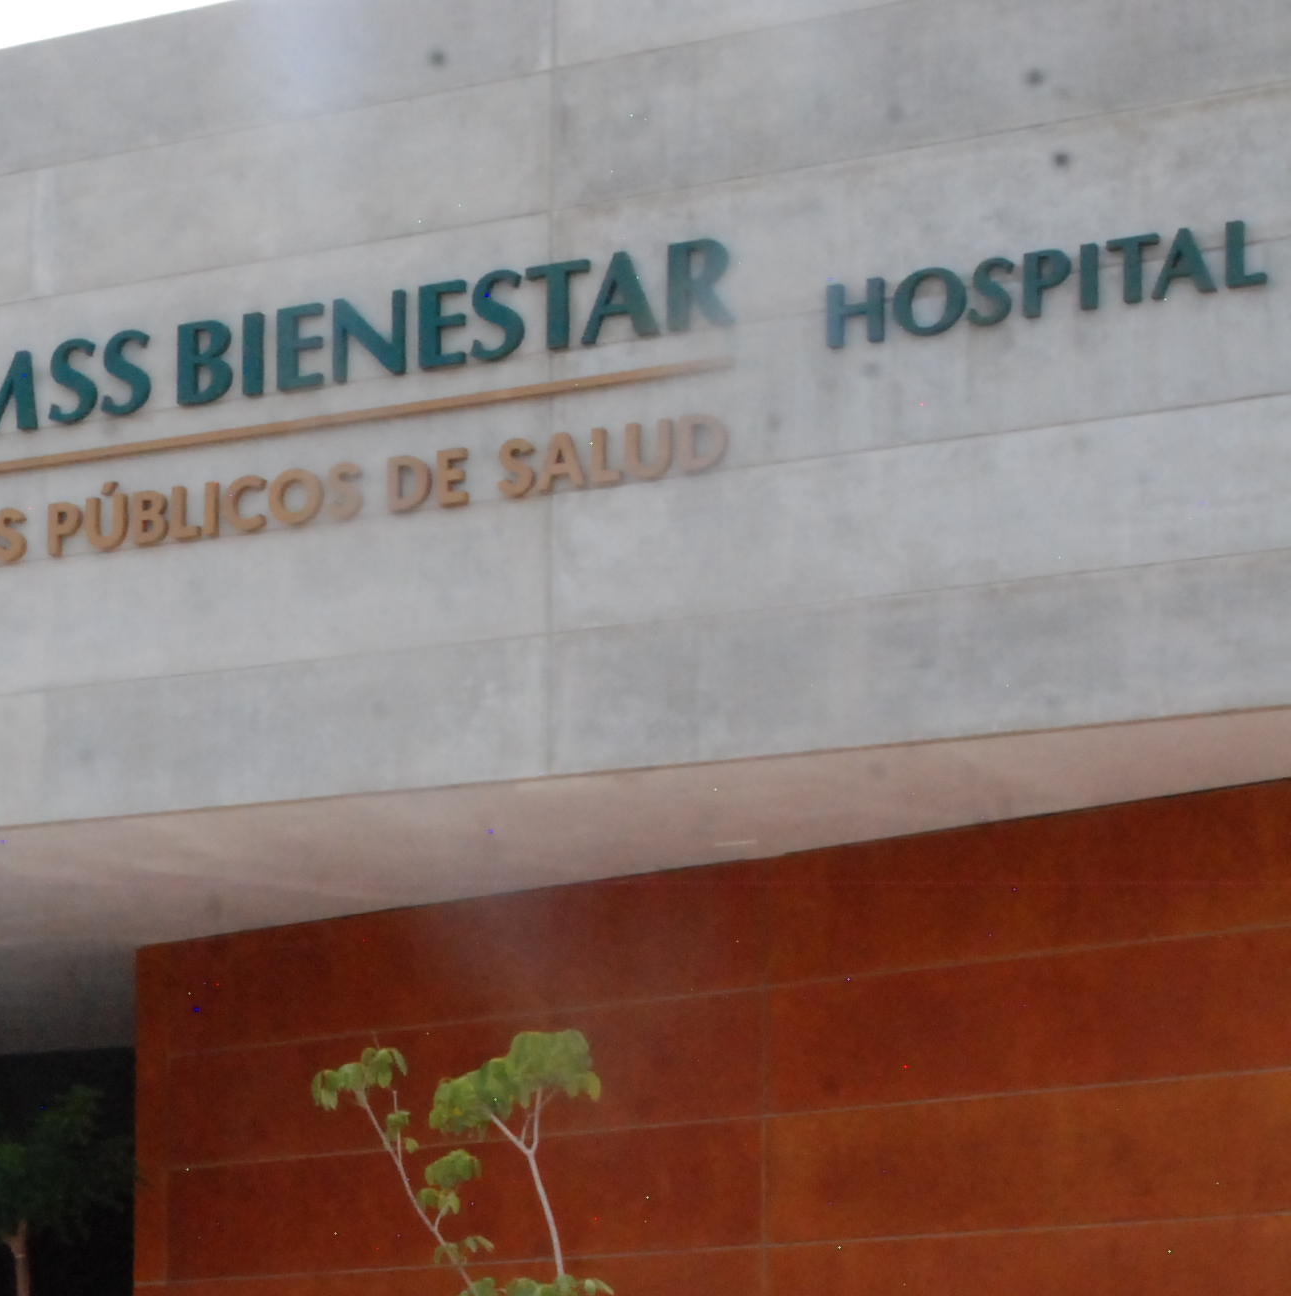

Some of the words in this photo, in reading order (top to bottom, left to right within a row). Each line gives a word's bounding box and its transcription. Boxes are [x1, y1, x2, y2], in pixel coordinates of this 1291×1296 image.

[176, 237, 735, 406] BIENESTAR
[826, 220, 1269, 349] HOSPITAL
[48, 463, 363, 556] PÚBLICOS
[388, 449, 470, 511] DE
[498, 415, 730, 498] SALUD
